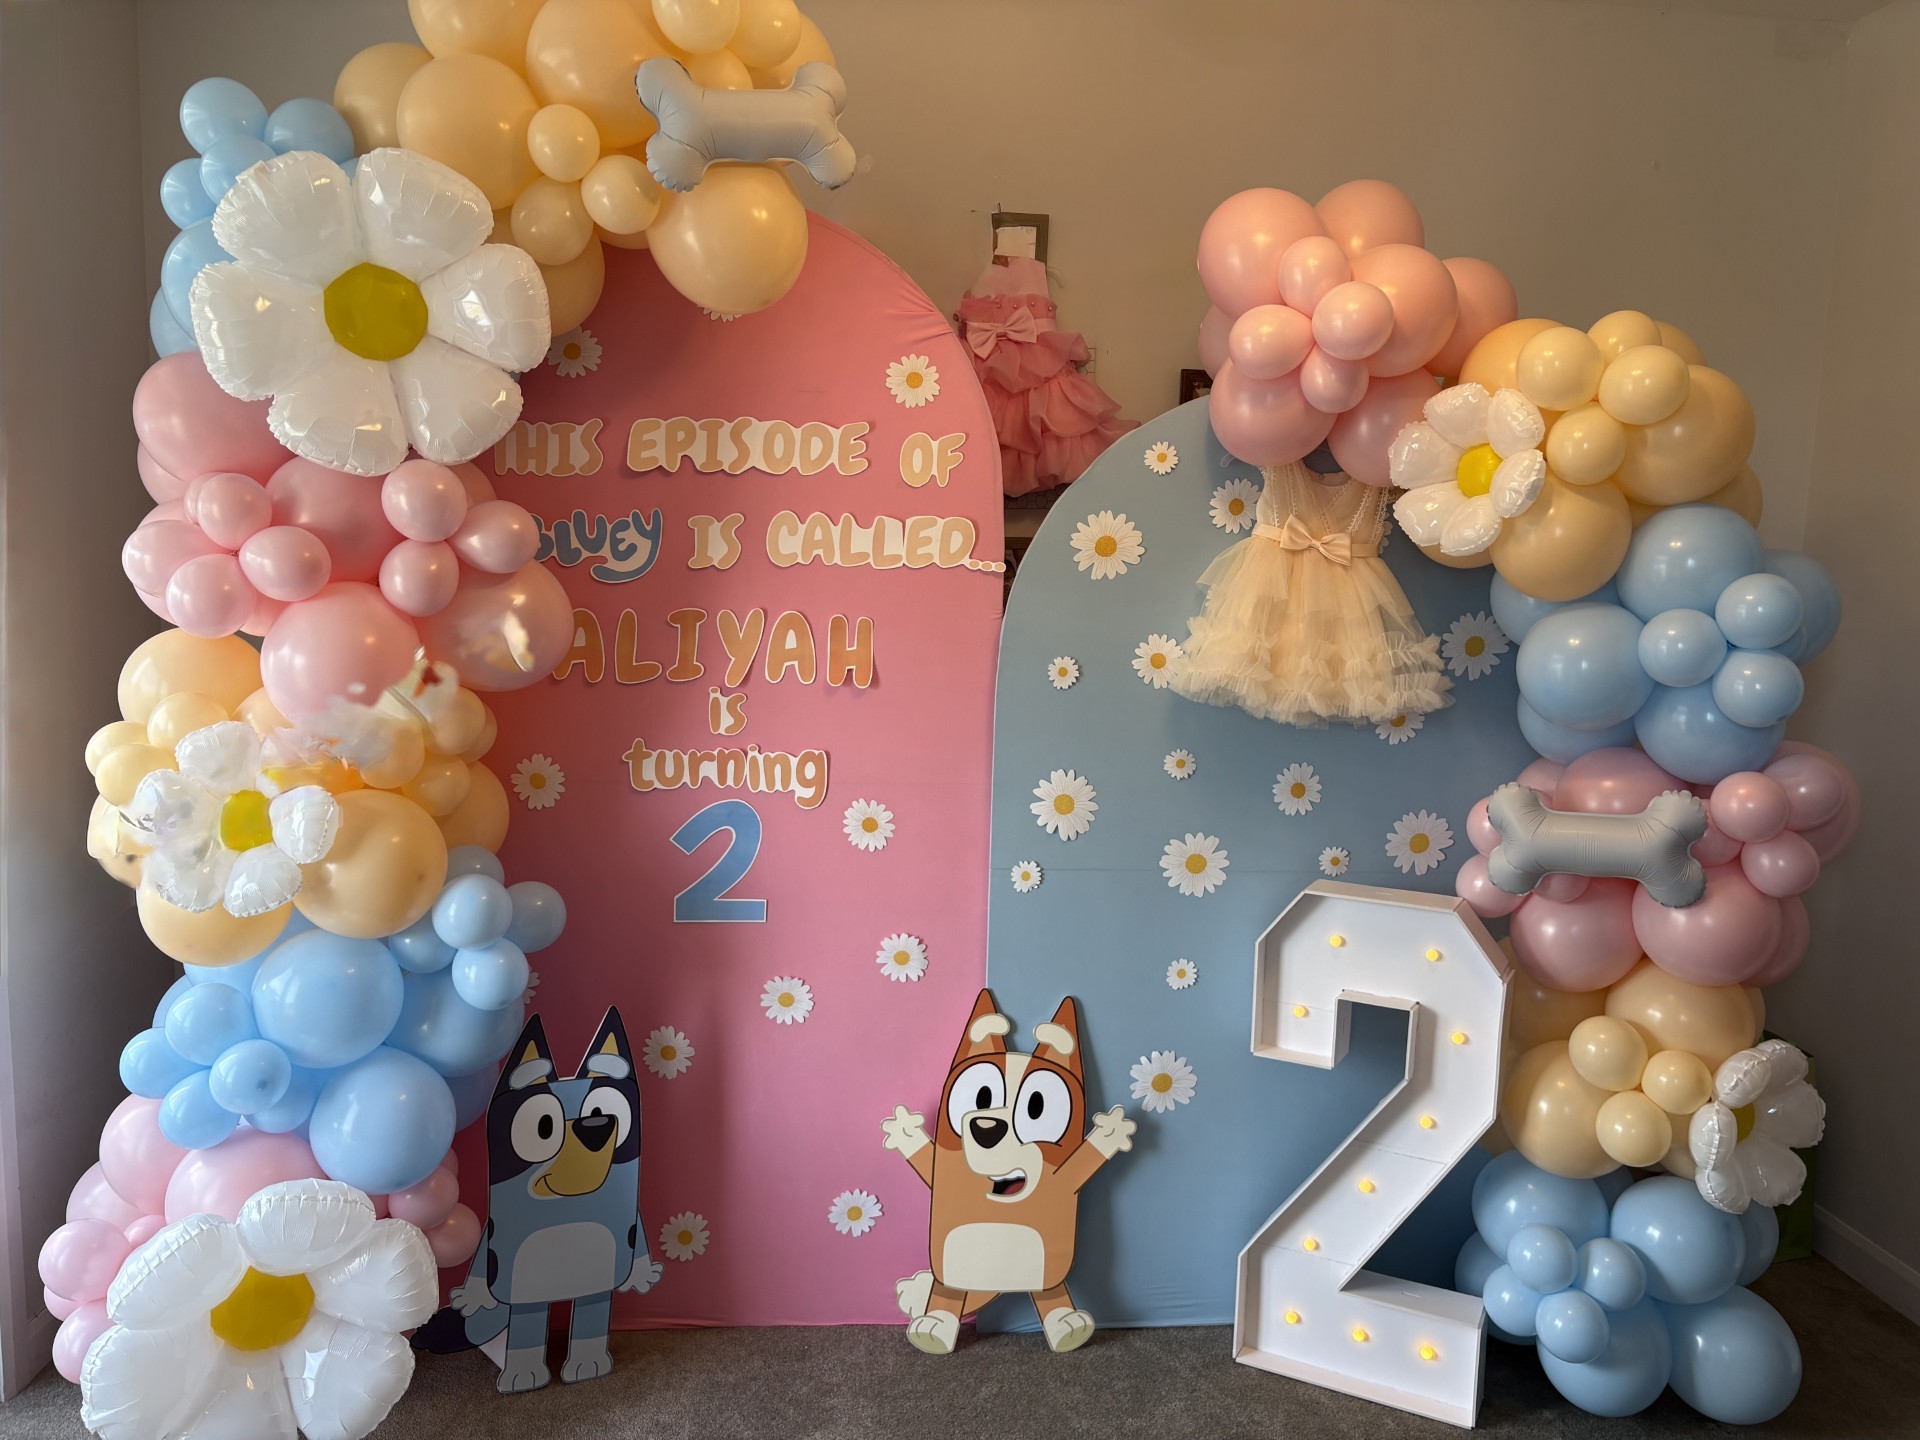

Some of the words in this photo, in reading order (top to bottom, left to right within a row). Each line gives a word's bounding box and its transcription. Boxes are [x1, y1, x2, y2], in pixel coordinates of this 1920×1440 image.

[628, 417, 869, 475] EPISODE
[901, 433, 965, 487] OF
[688, 513, 744, 569] IS
[767, 511, 1006, 569] CALLED...
[552, 608, 873, 688] ALIYAH
[709, 687, 747, 735] is
[623, 738, 827, 809] turning
[670, 799, 767, 922] 2
[1234, 879, 1514, 1429] 2
